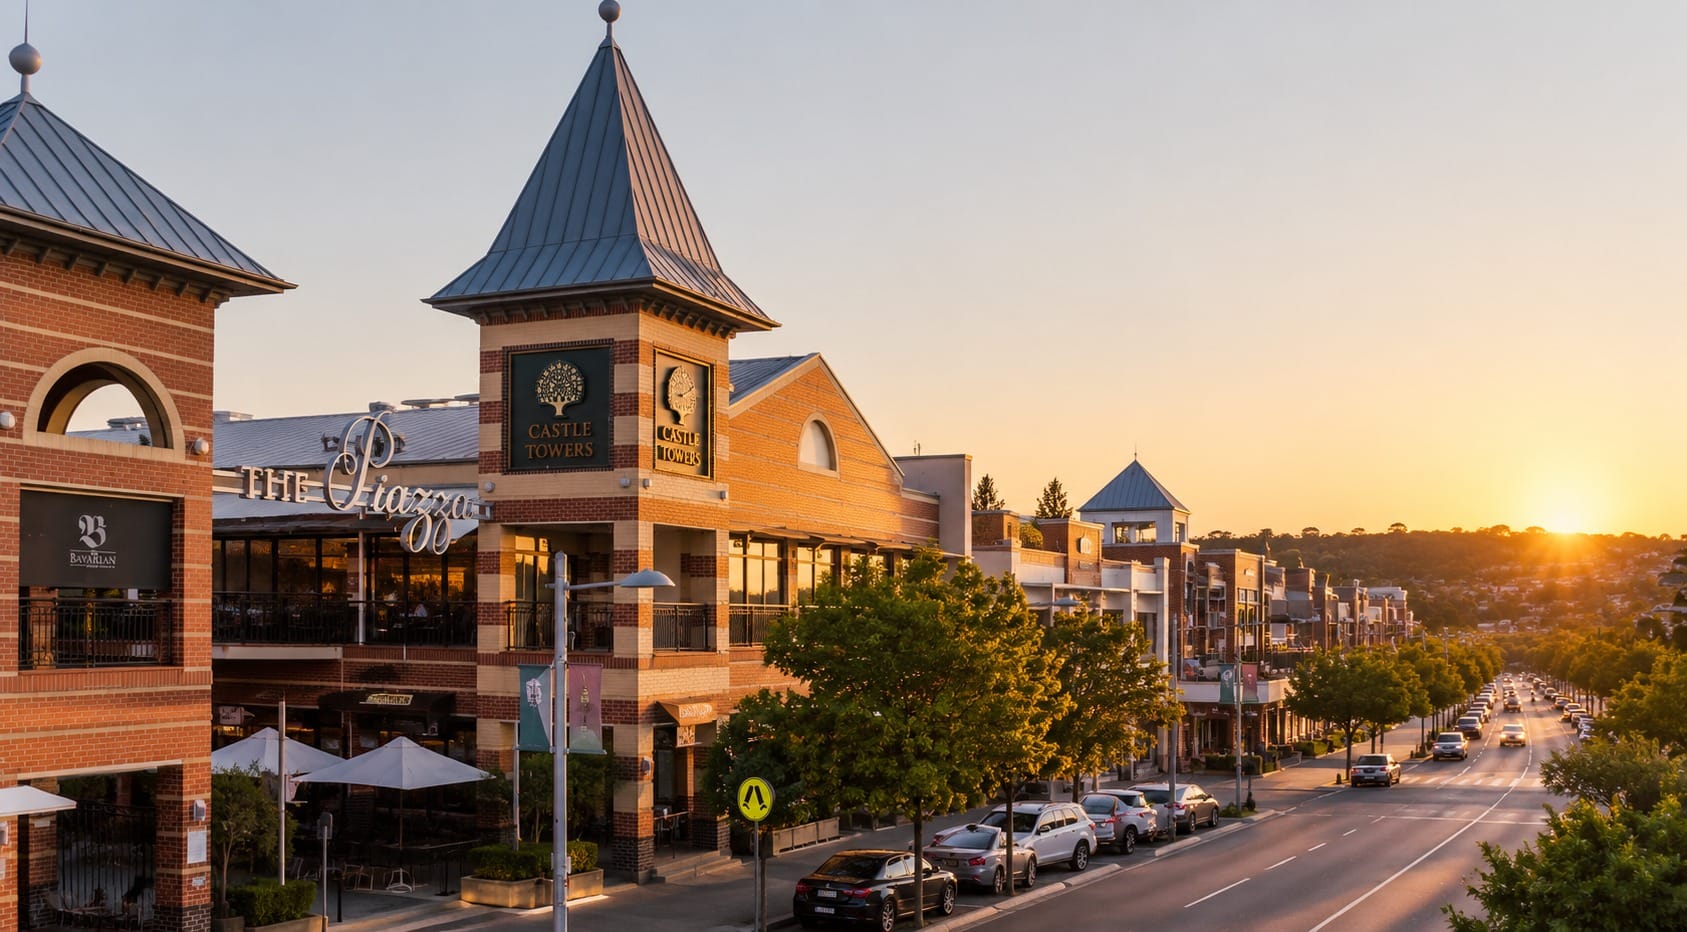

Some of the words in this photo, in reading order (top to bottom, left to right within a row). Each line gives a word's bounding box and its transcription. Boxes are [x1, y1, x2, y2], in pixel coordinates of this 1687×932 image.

[528, 422, 592, 440] CASTLE
[662, 425, 701, 446] CASTLE
[525, 442, 593, 460] TOWERS
[662, 445, 701, 466] TOWERS
[240, 465, 309, 503] THE
[323, 410, 475, 555] Piazza
[78, 514, 107, 548] B
[70, 552, 116, 565] BAVARIAN
